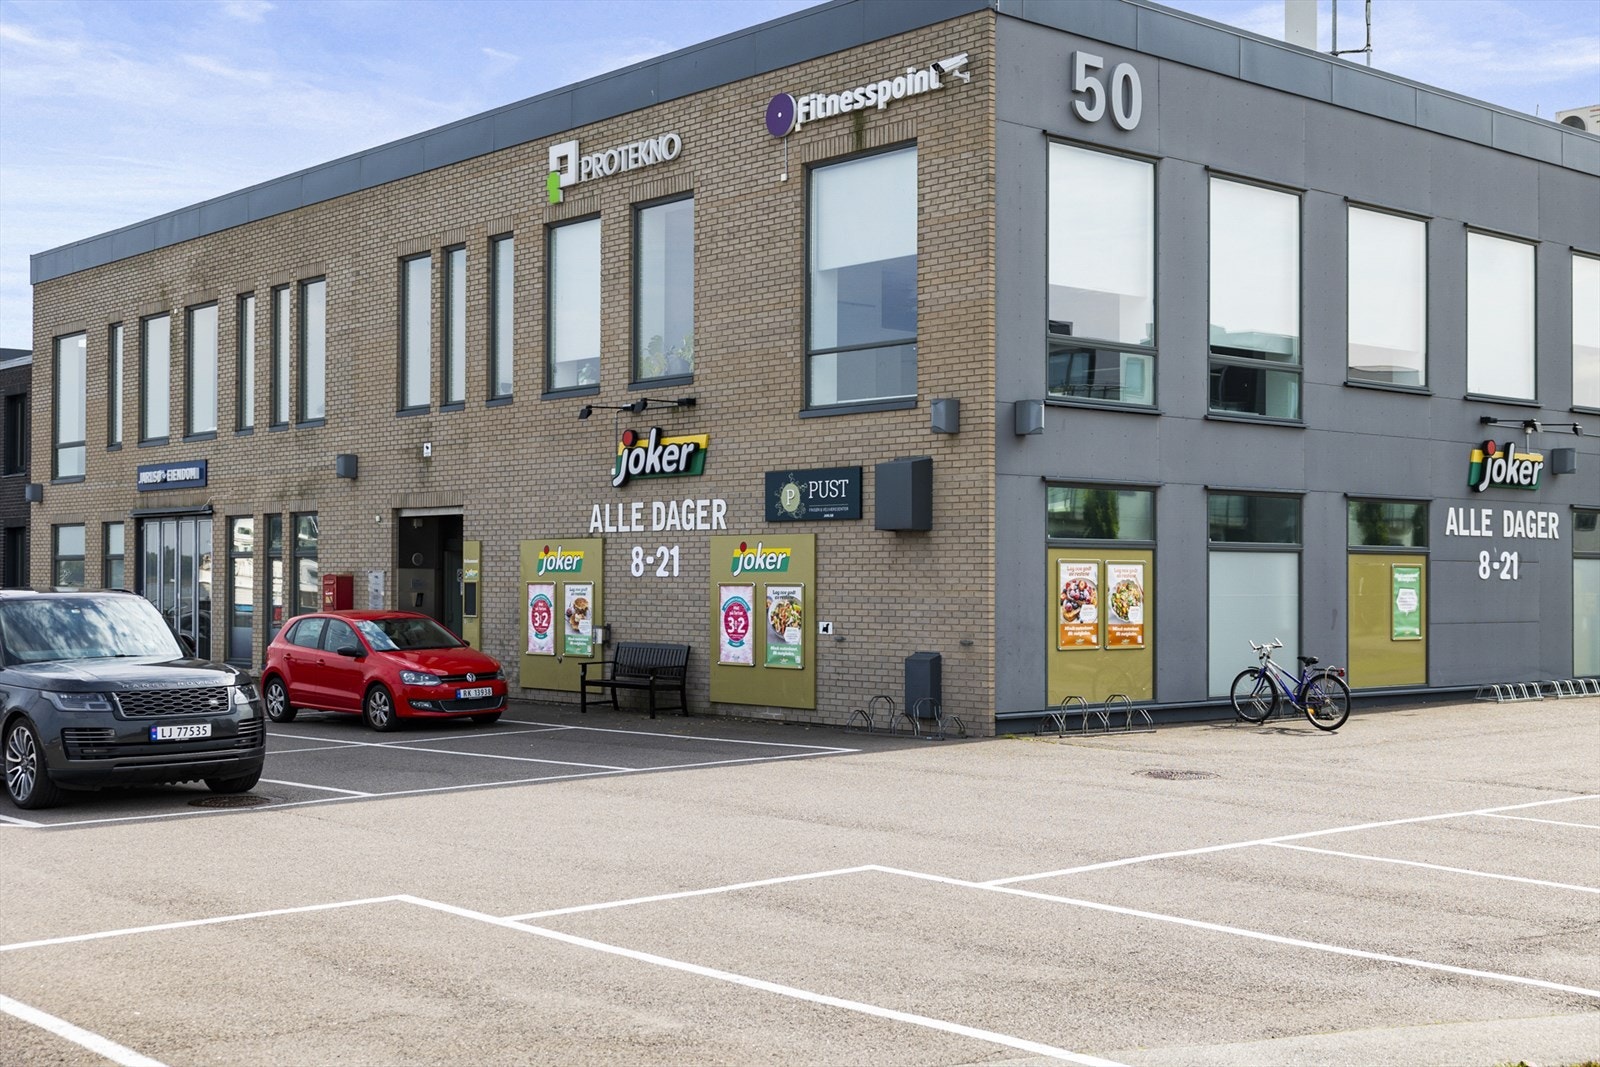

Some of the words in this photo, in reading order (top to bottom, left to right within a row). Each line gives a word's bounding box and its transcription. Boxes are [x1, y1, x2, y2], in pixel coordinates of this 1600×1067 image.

[1070, 50, 1143, 131] 50
[579, 133, 683, 182] PROTEKNO
[612, 427, 696, 488] joker
[1477, 440, 1544, 492] joker
[808, 479, 849, 499] PUST
[589, 503, 645, 534] ALLE
[652, 498, 728, 532] DAGER
[1445, 507, 1494, 537] ALLE
[1503, 509, 1560, 540] DAGER
[538, 545, 581, 577] joker
[732, 541, 787, 577] joker
[161, 727, 173, 738] LJ
[176, 725, 208, 738] 77535
